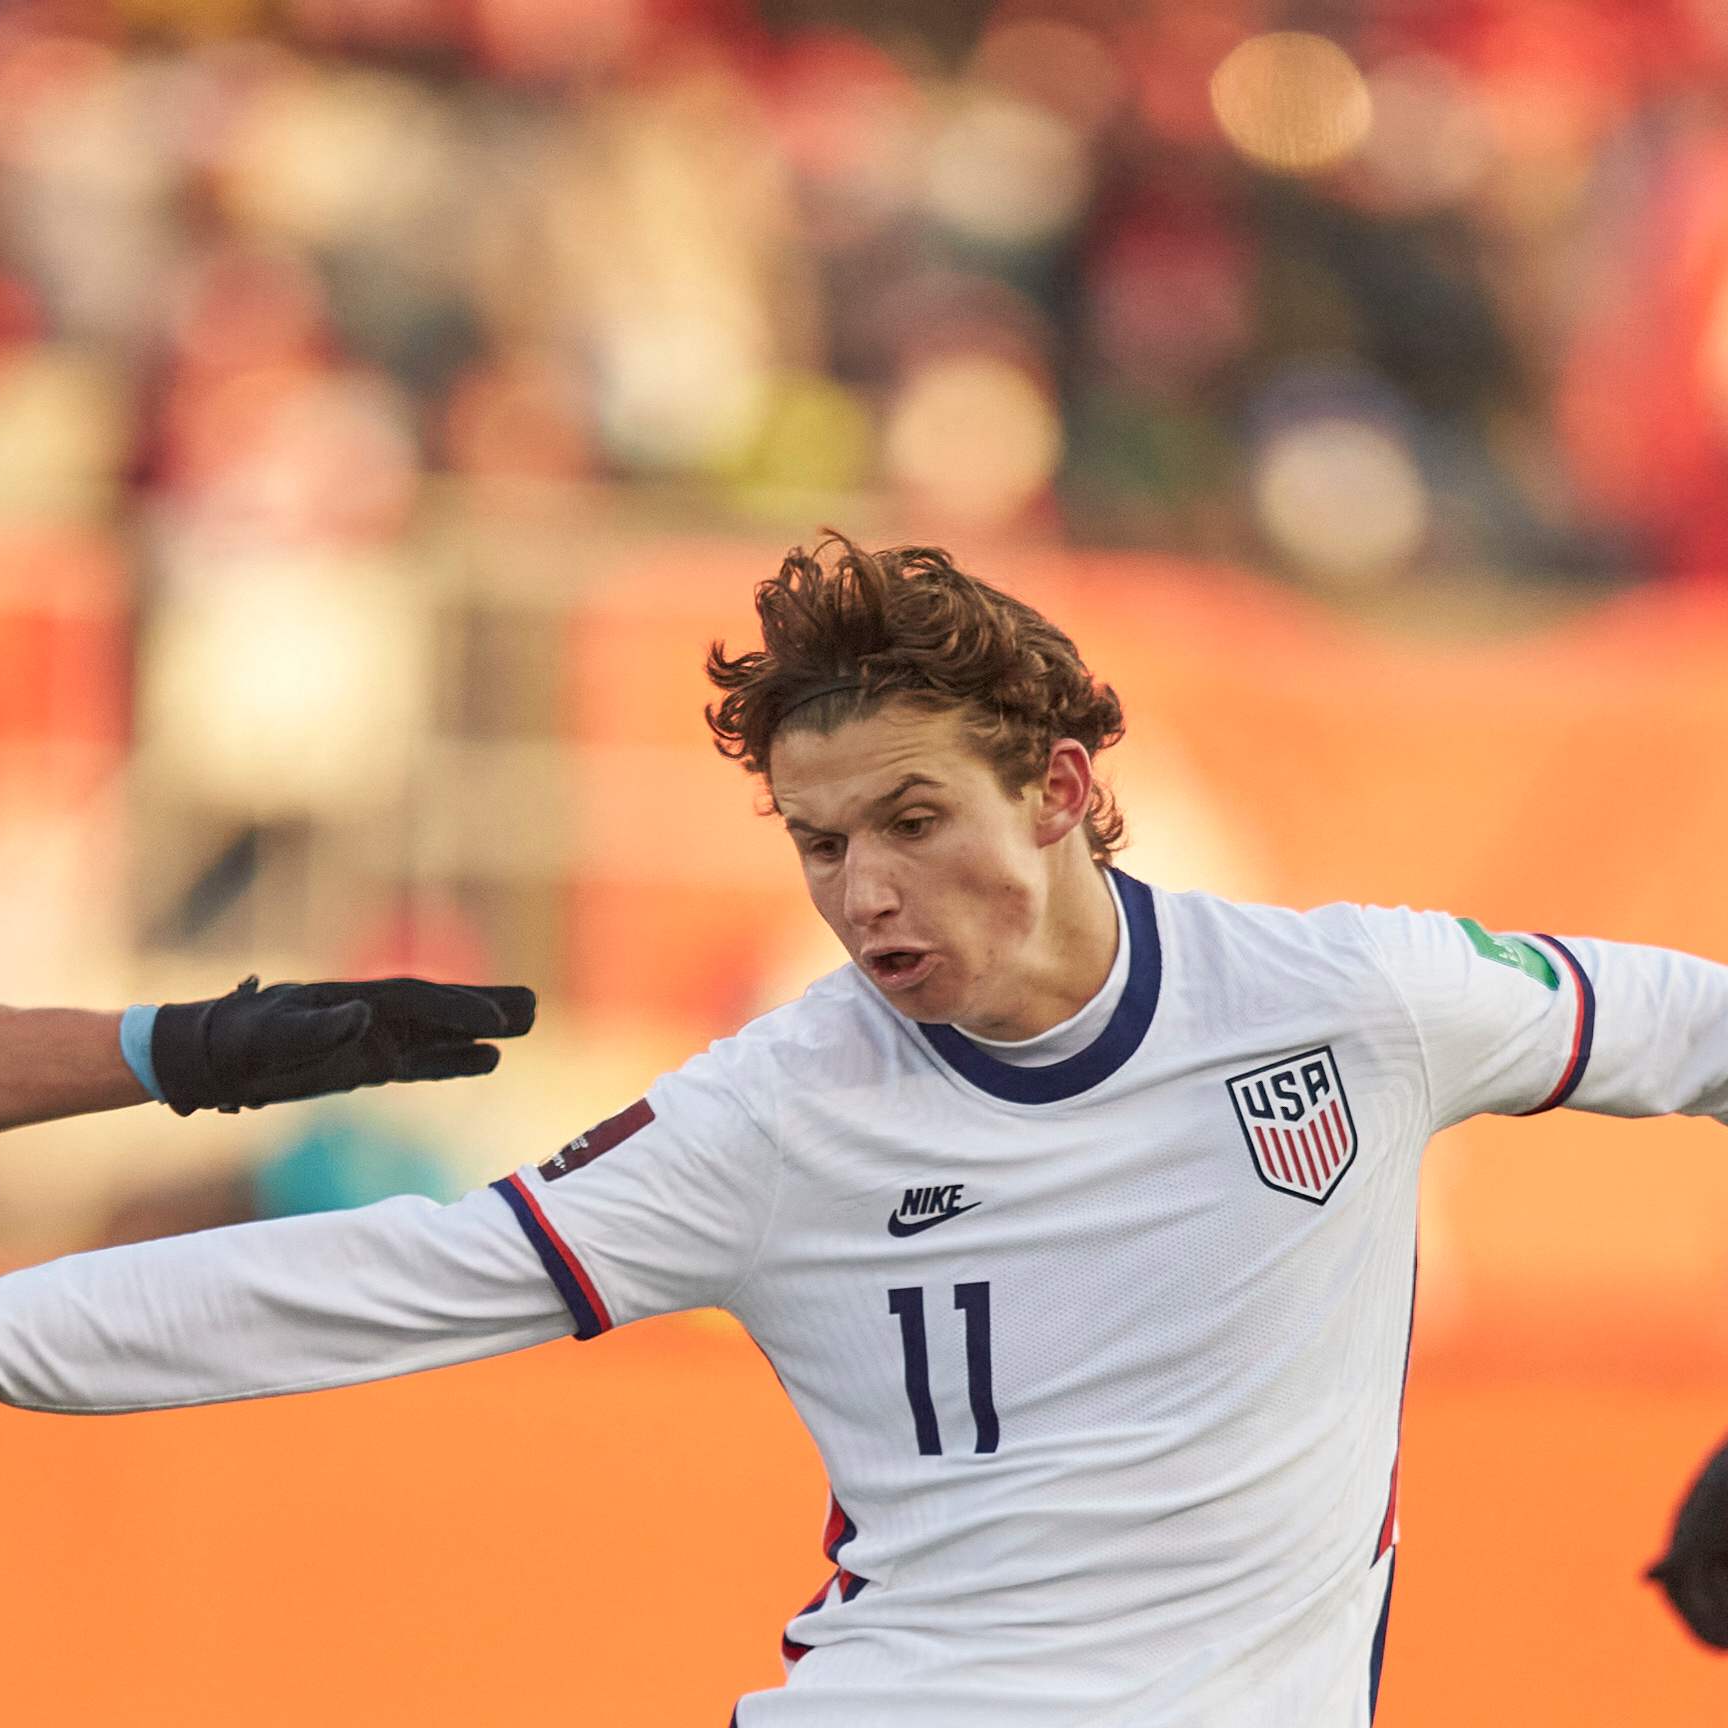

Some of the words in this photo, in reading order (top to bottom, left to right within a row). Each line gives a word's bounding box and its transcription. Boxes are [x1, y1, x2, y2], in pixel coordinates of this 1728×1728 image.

[1241, 1060, 1330, 1122] USA
[899, 1184, 964, 1217] NIKE
[888, 1281, 1000, 1456] 11
